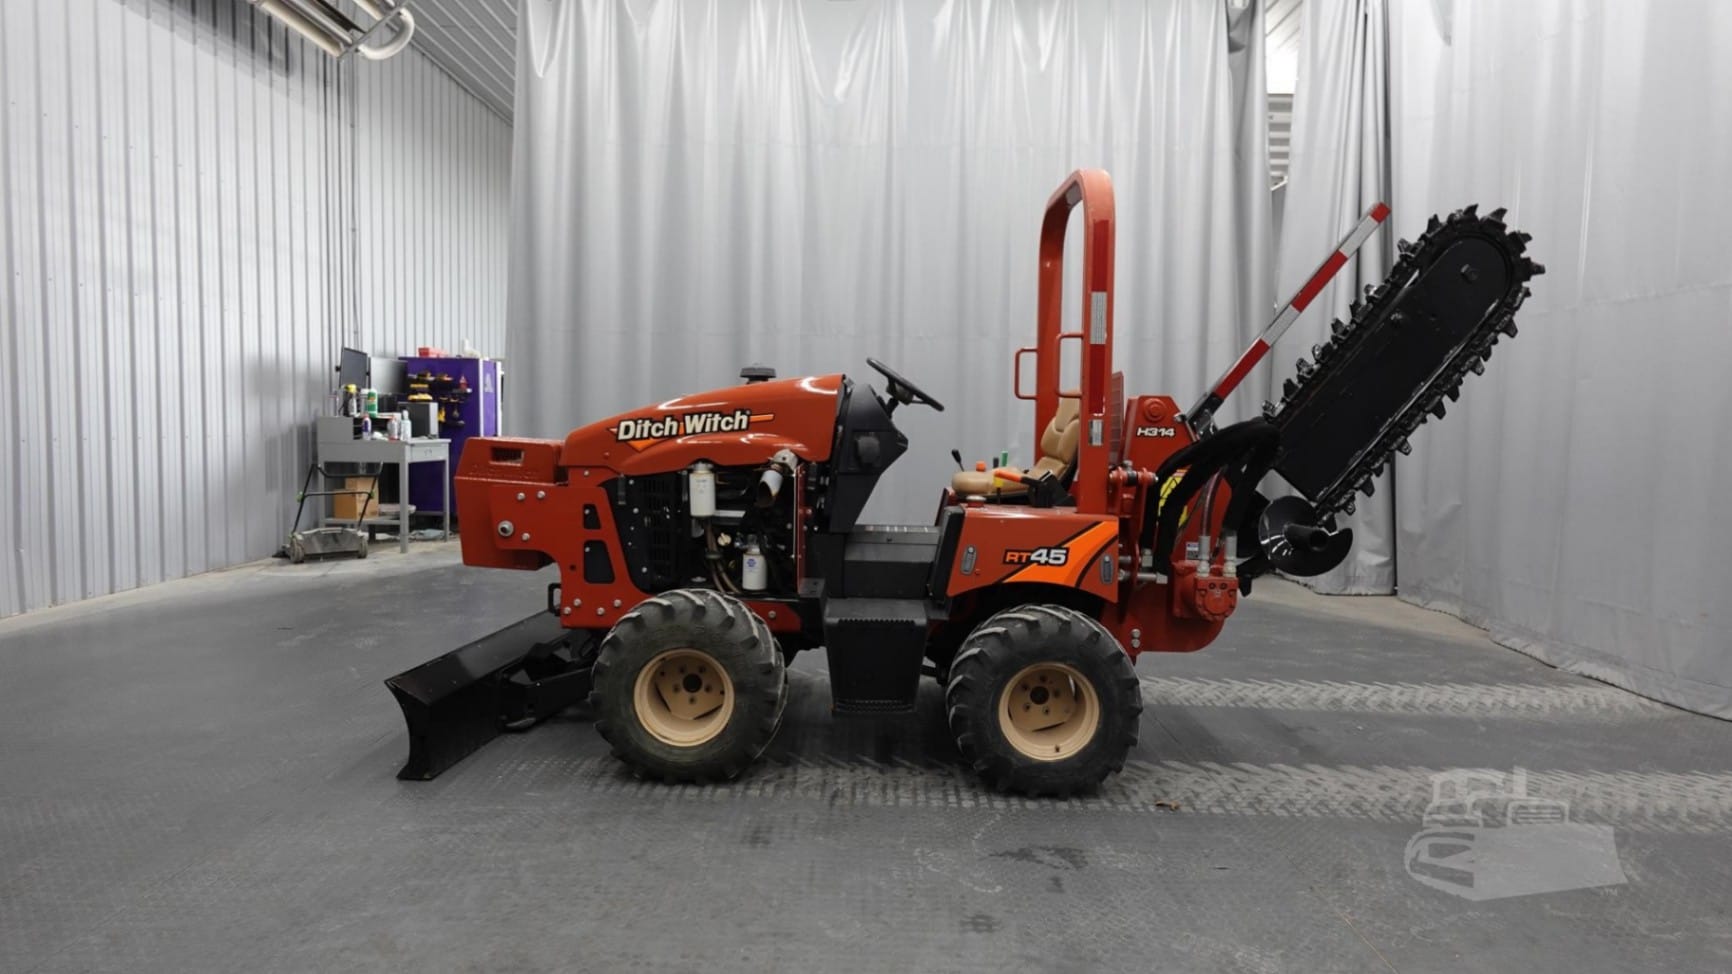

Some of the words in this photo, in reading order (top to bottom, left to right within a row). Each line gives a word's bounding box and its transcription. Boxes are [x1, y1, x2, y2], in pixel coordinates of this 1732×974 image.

[618, 417, 678, 441] Ditch
[684, 410, 749, 435] Witch
[1136, 427, 1175, 437] H314
[1005, 548, 1067, 565] RT45
